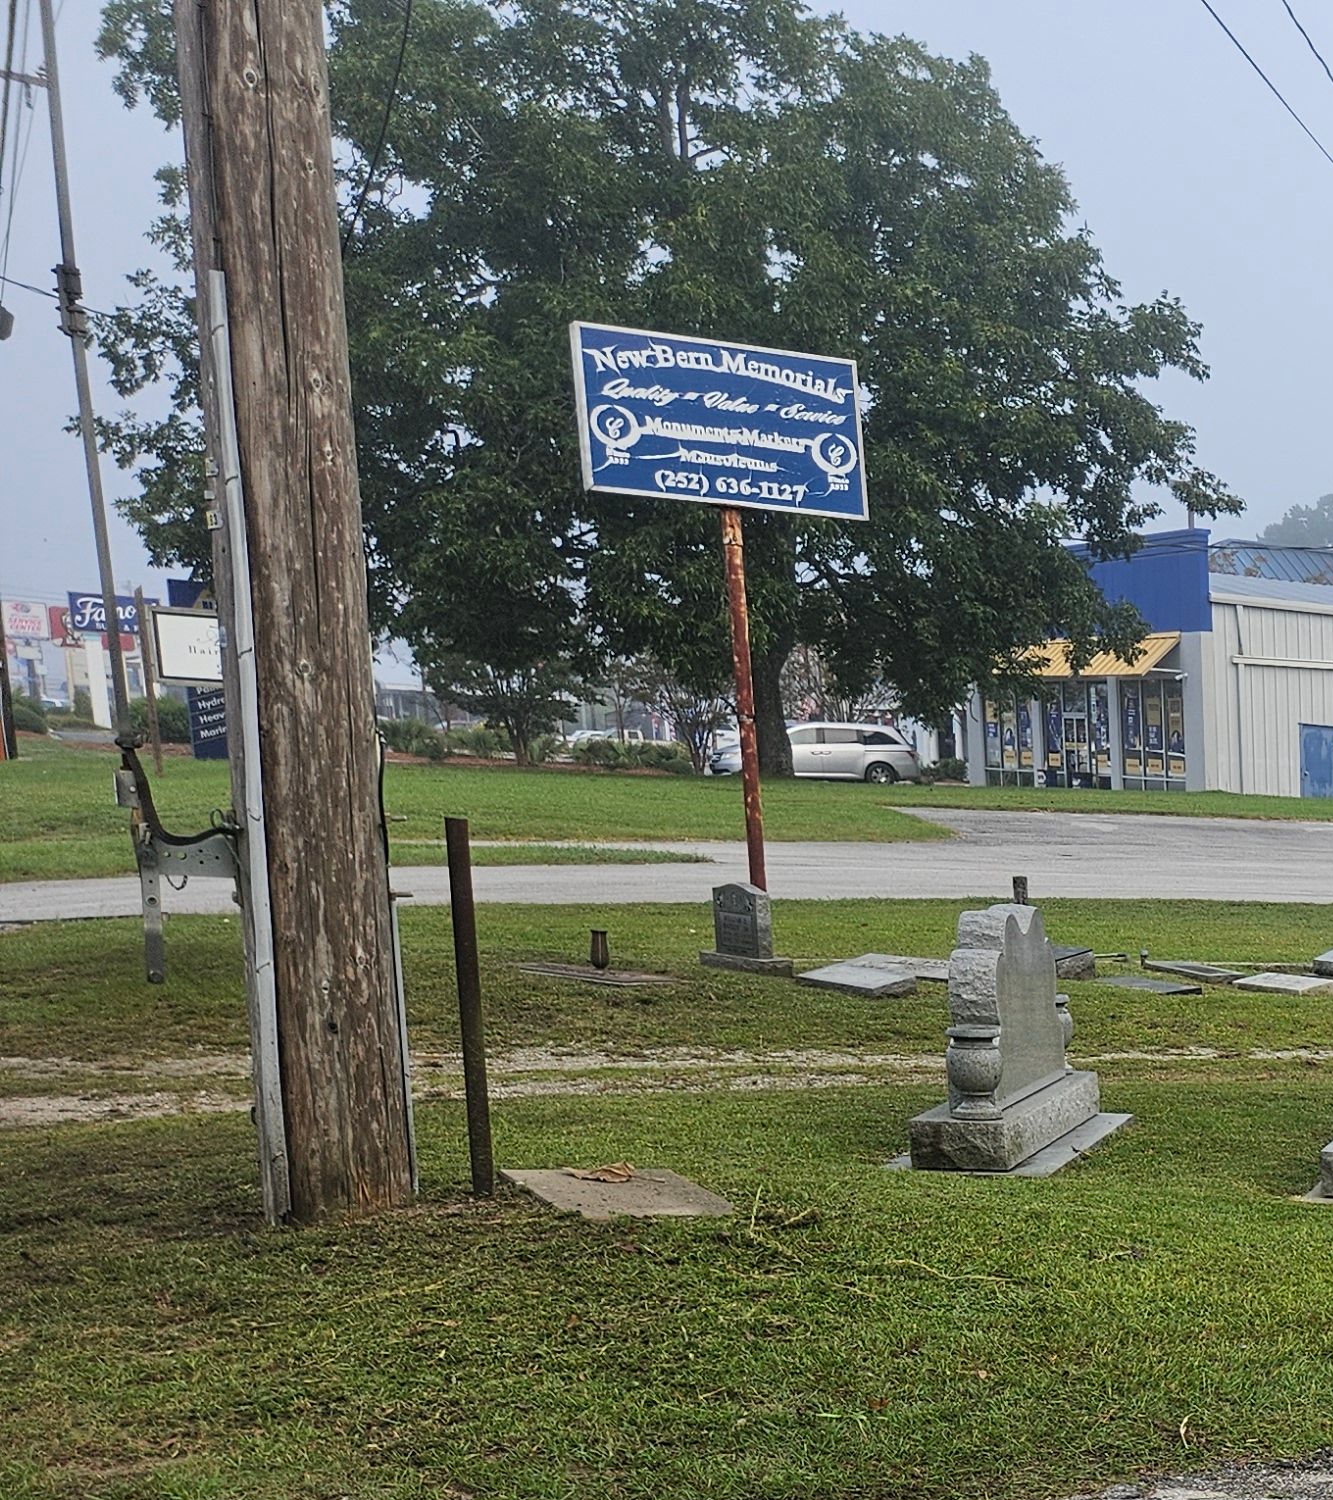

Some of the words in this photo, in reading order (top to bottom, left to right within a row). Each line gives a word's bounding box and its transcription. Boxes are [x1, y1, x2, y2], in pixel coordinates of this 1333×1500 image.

[583, 344, 649, 376] New
[649, 342, 716, 371] Bern
[720, 349, 853, 404] Memorials
[601, 378, 680, 406] Quality
[703, 391, 759, 414] Value
[780, 404, 847, 425] Service
[655, 469, 709, 496] (252)
[716, 476, 808, 507] 636-1127
